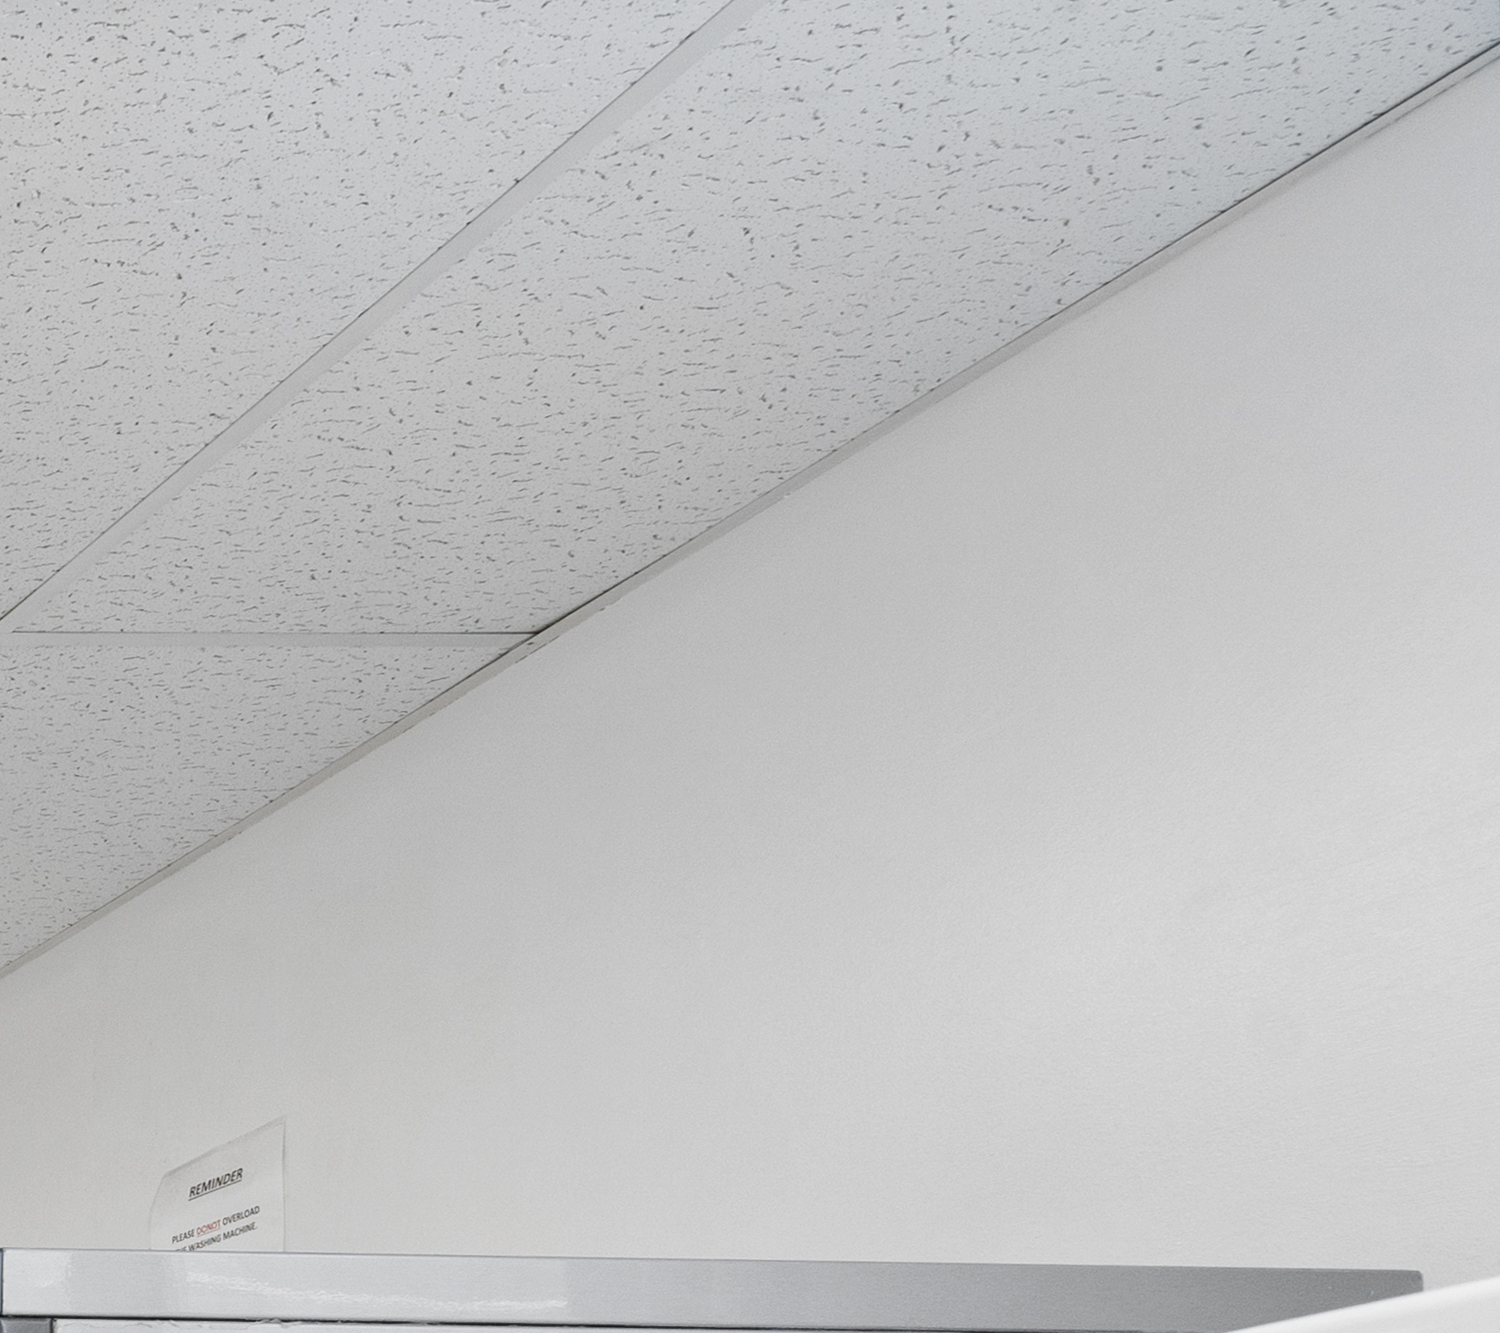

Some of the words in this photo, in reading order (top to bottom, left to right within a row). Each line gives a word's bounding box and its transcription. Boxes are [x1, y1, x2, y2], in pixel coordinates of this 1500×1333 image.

[188, 1168, 243, 1200] REMINDER
[171, 1228, 196, 1245] PLEASE
[222, 1205, 260, 1226] OVERLOAD
[188, 1233, 222, 1251] WASHING
[222, 1222, 258, 1240] MACHINE.
